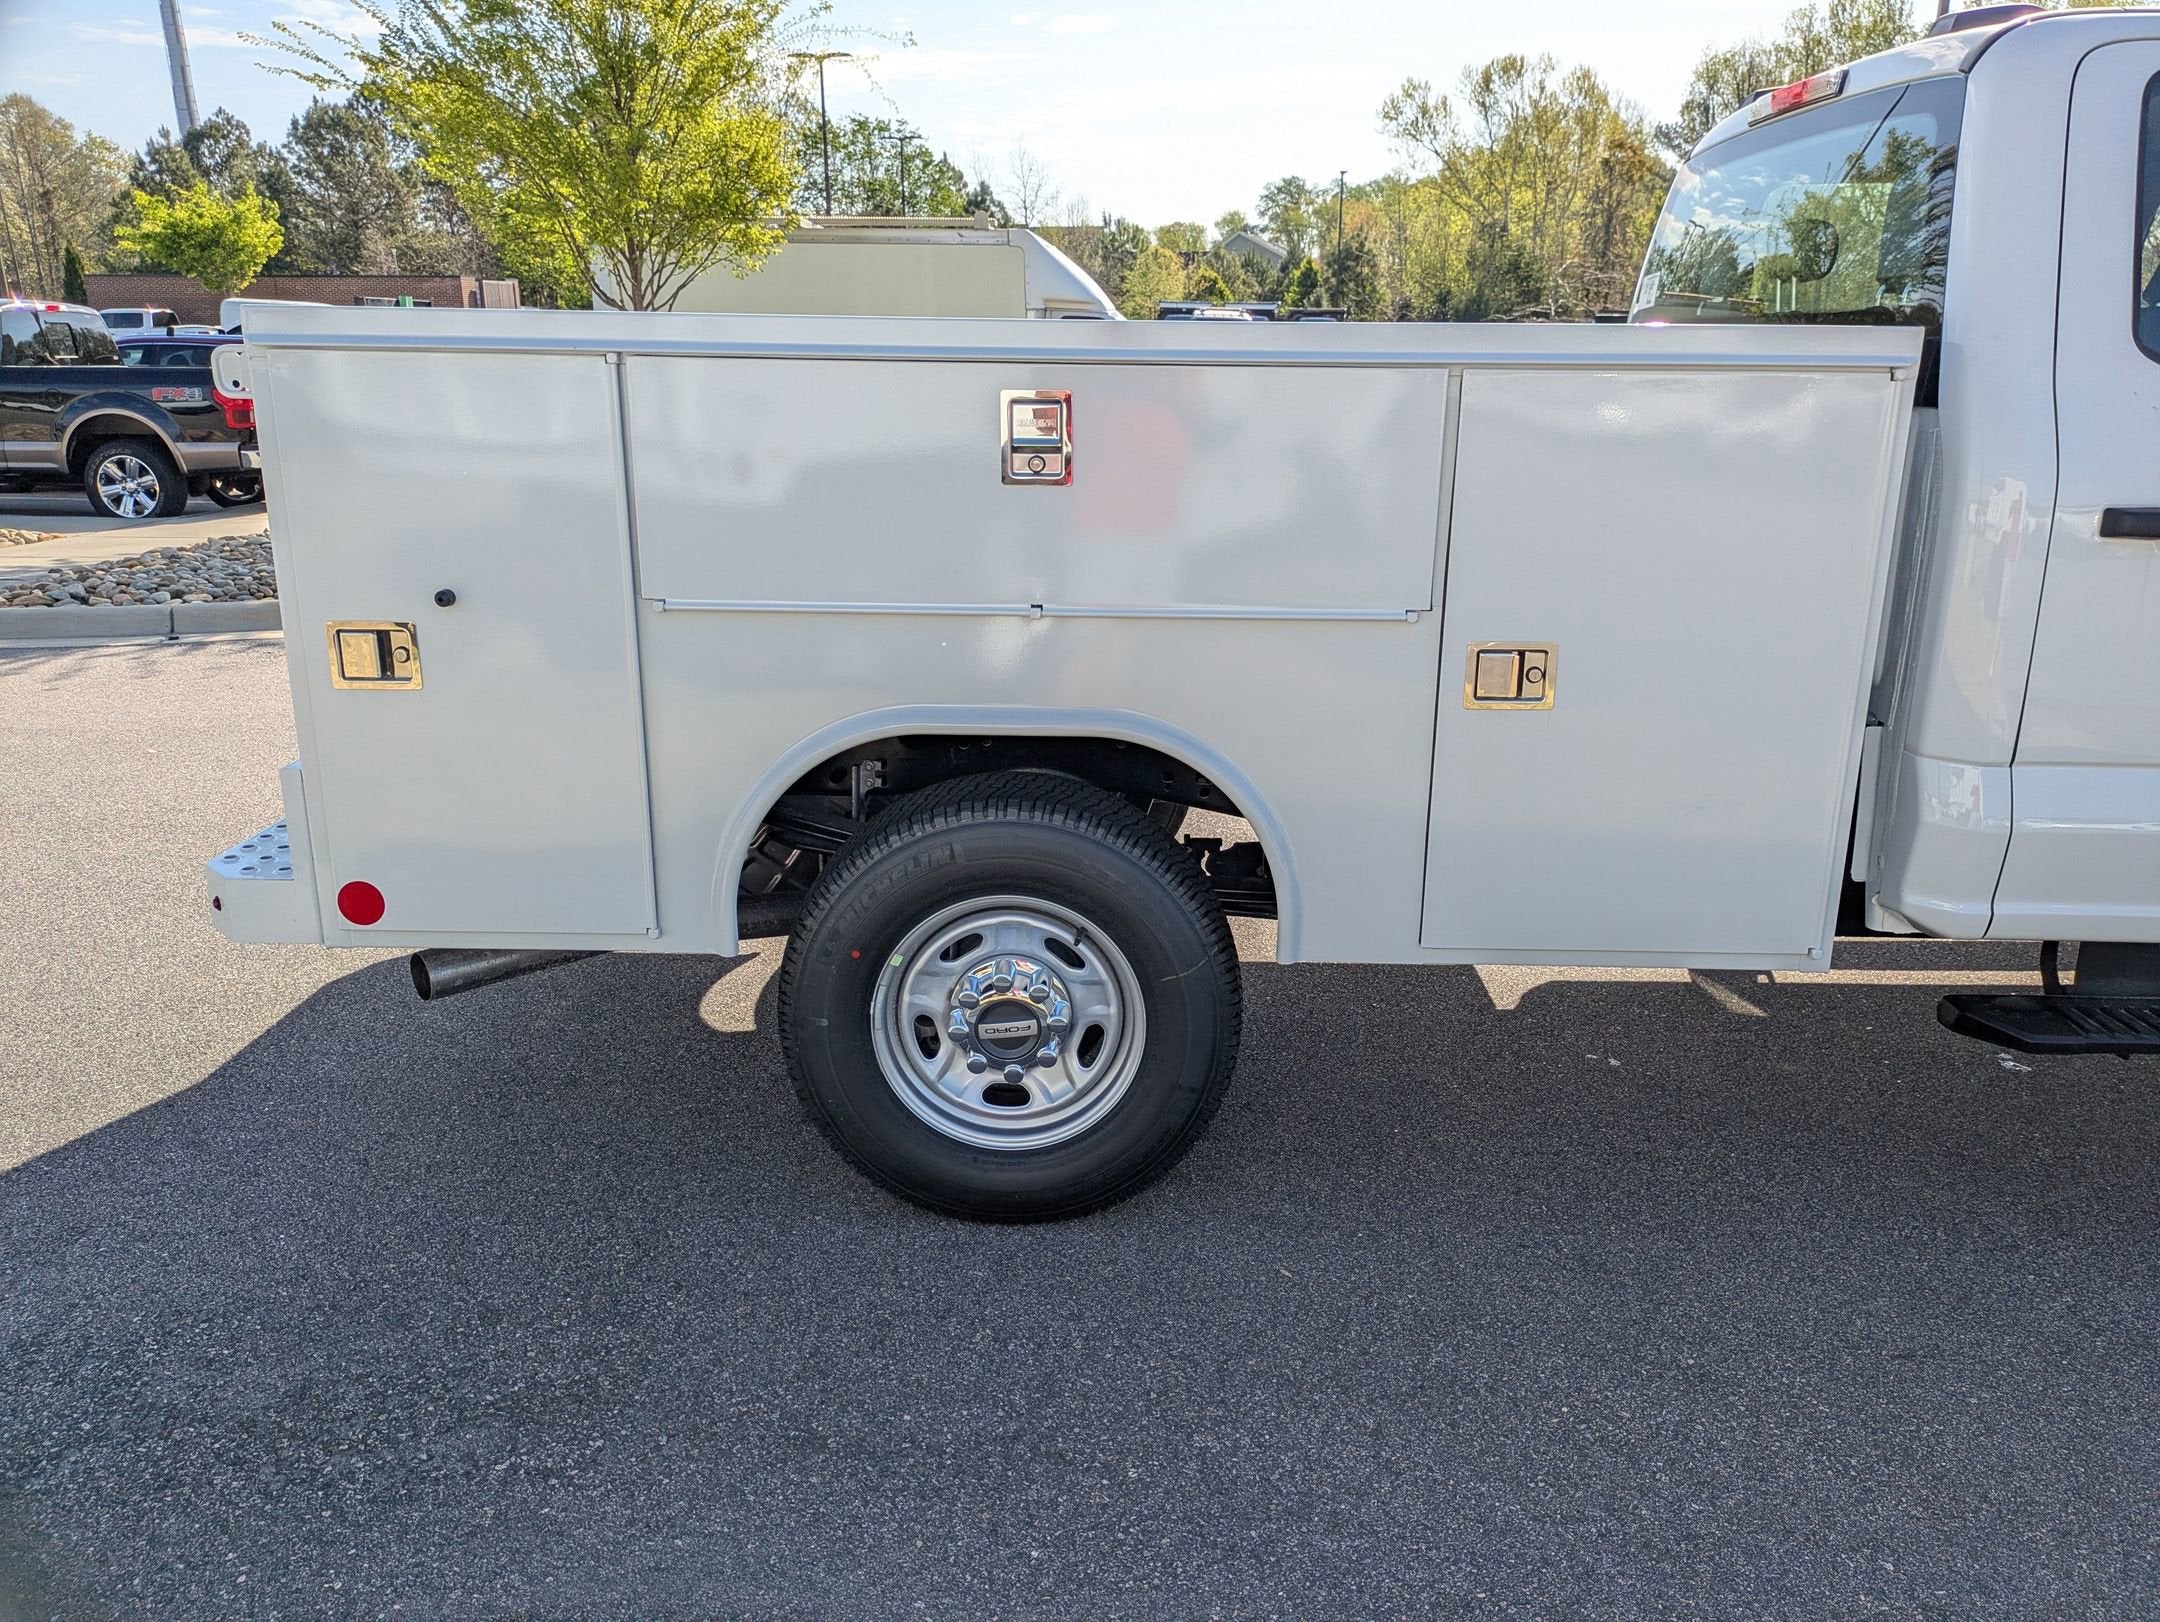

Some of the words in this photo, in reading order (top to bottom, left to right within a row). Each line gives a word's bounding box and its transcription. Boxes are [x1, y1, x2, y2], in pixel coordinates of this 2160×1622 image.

[152, 387, 203, 401] FX4
[835, 842, 957, 936] MICHELIN
[984, 1024, 1032, 1035] FORD
